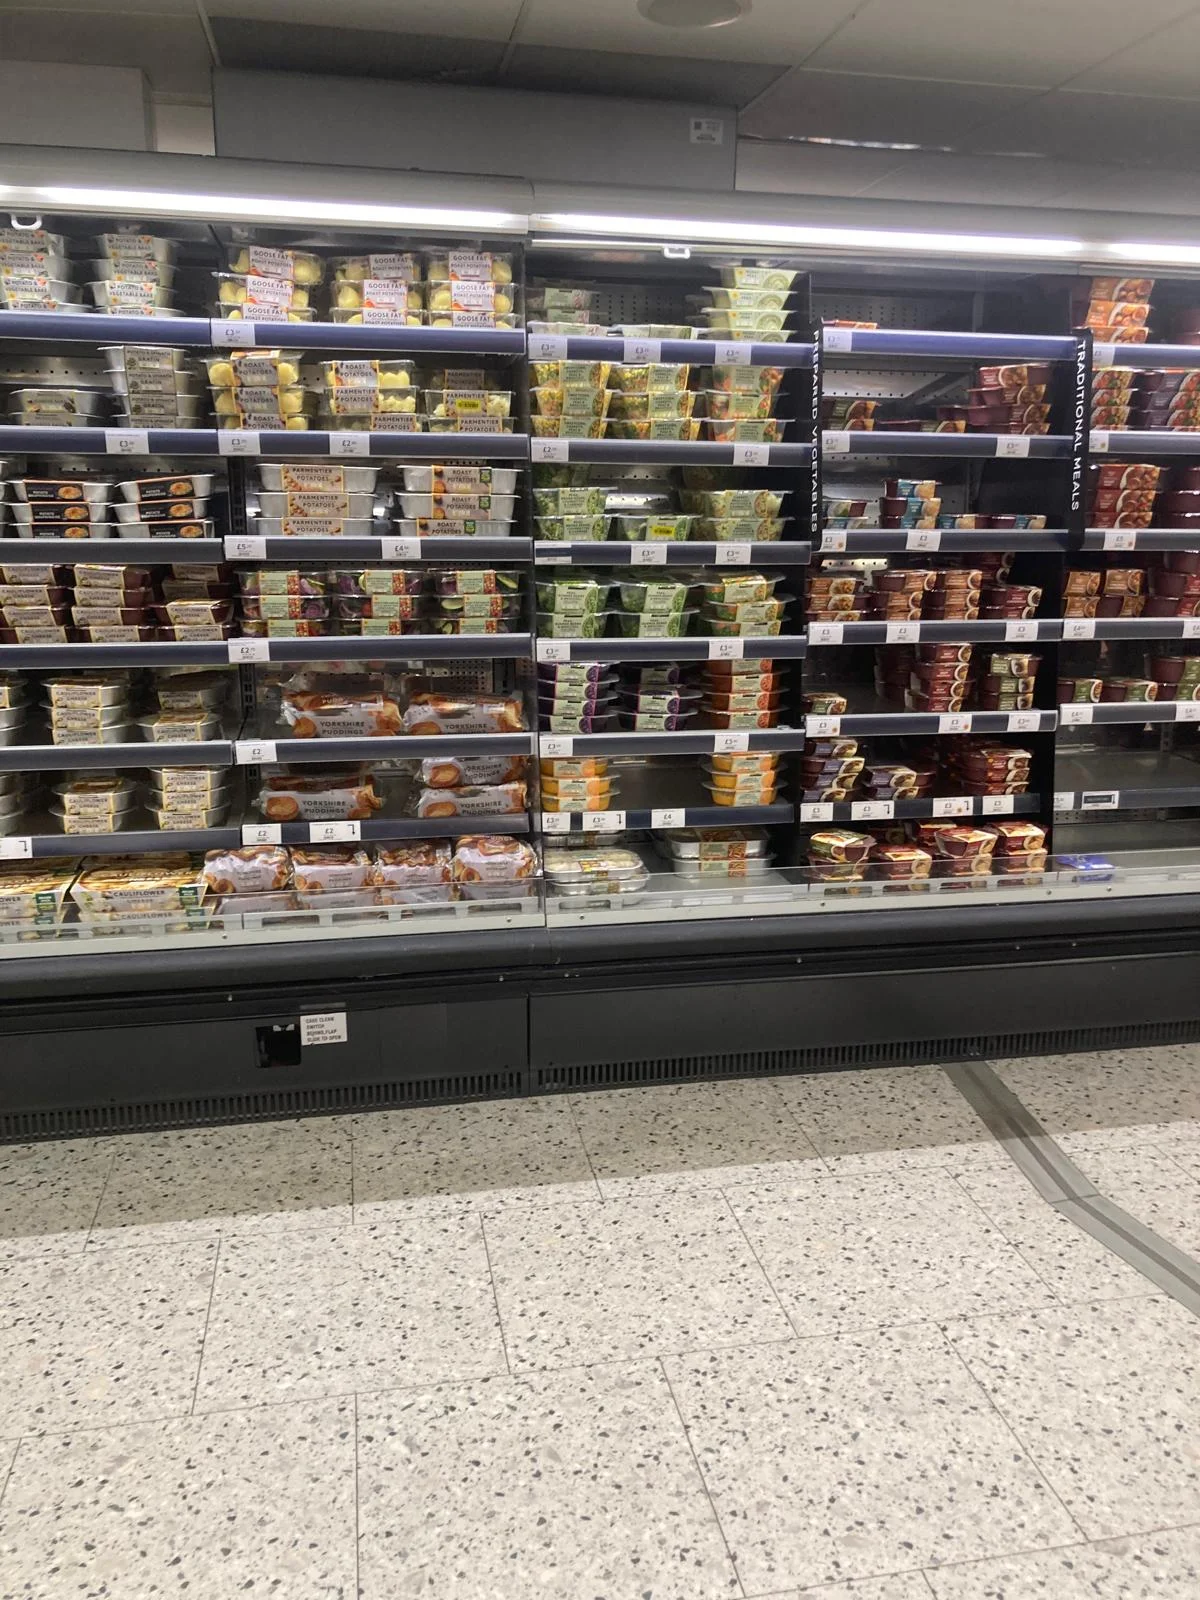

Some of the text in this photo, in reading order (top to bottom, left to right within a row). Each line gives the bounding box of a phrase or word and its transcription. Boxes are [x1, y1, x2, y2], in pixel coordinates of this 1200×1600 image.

[254, 250, 276, 258] GOOSE
[1071, 340, 1087, 511] TRADITIONAL MEALS
[811, 425, 819, 533] VEGETABLES
[113, 889, 165, 897] CAULIFLOWER
